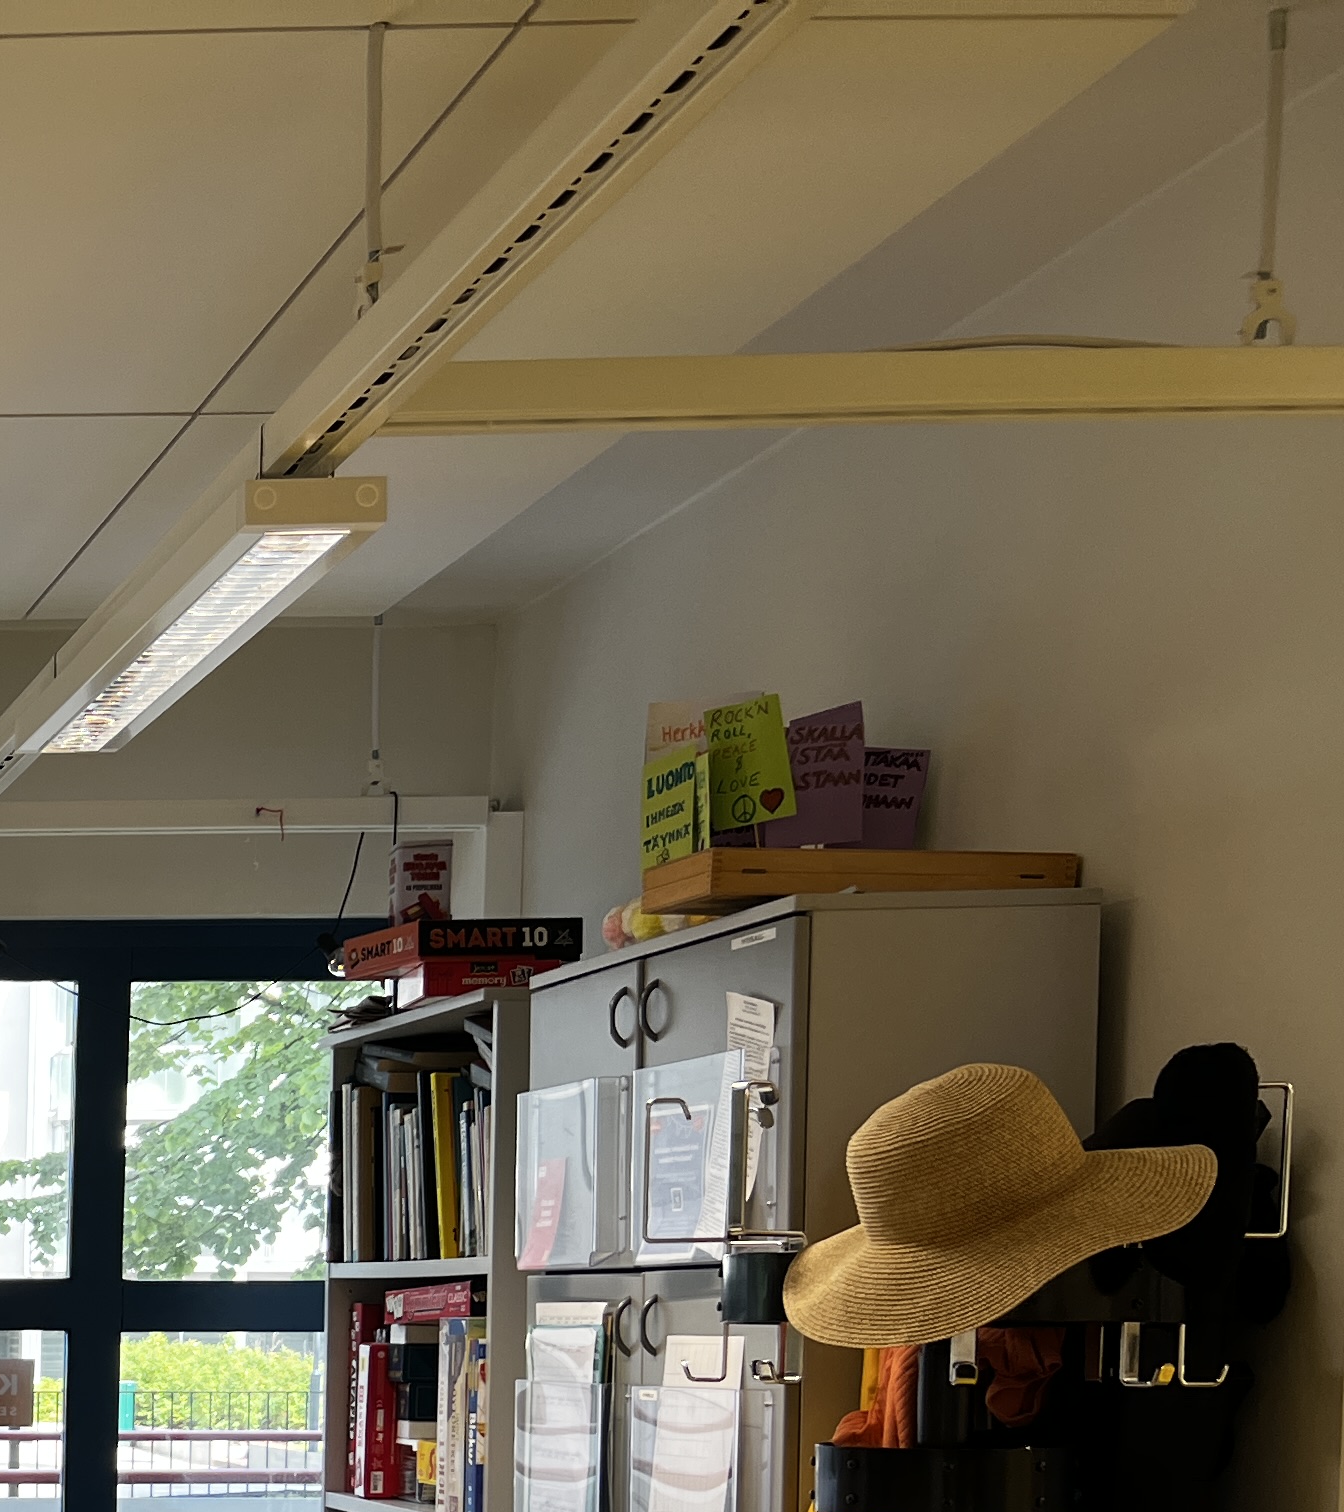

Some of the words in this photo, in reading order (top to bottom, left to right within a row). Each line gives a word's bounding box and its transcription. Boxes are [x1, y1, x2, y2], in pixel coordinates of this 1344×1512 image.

[662, 723, 706, 743] Herkk
[711, 739, 757, 760] PEACE
[647, 761, 695, 799] LUONTO
[716, 772, 760, 794] LOVE
[795, 769, 862, 791] STAAN
[429, 928, 516, 948] SMART
[522, 927, 548, 947] 10
[361, 940, 391, 962] SMART
[392, 938, 403, 953] 10
[462, 976, 507, 988] memory
[468, 1412, 477, 1466] Blokus
